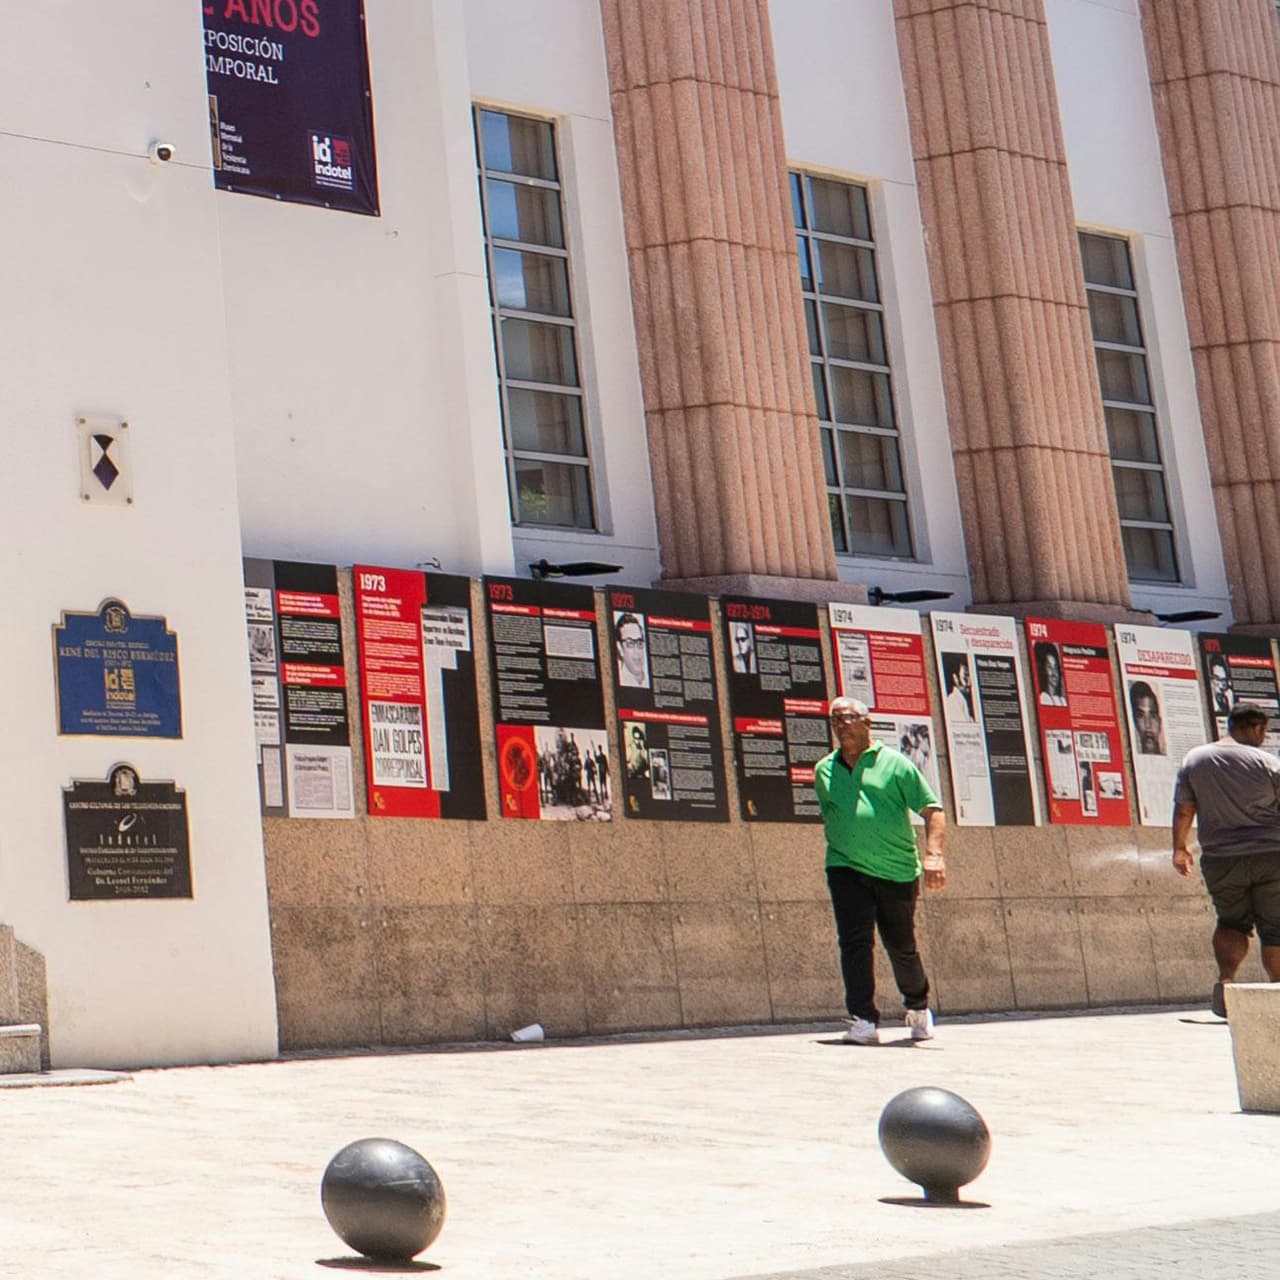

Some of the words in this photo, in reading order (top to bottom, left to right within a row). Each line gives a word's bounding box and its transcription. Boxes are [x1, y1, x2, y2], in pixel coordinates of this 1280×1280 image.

[206, 29, 283, 61] POSICIÓN
[206, 54, 279, 85] MPORAL
[315, 161, 352, 179] indotel
[359, 573, 387, 592] 1973
[489, 583, 514, 601] 1973
[833, 608, 853, 624] 1974
[936, 618, 954, 633] 1974
[373, 727, 390, 753] DAN
[393, 728, 422, 755] GOLPES
